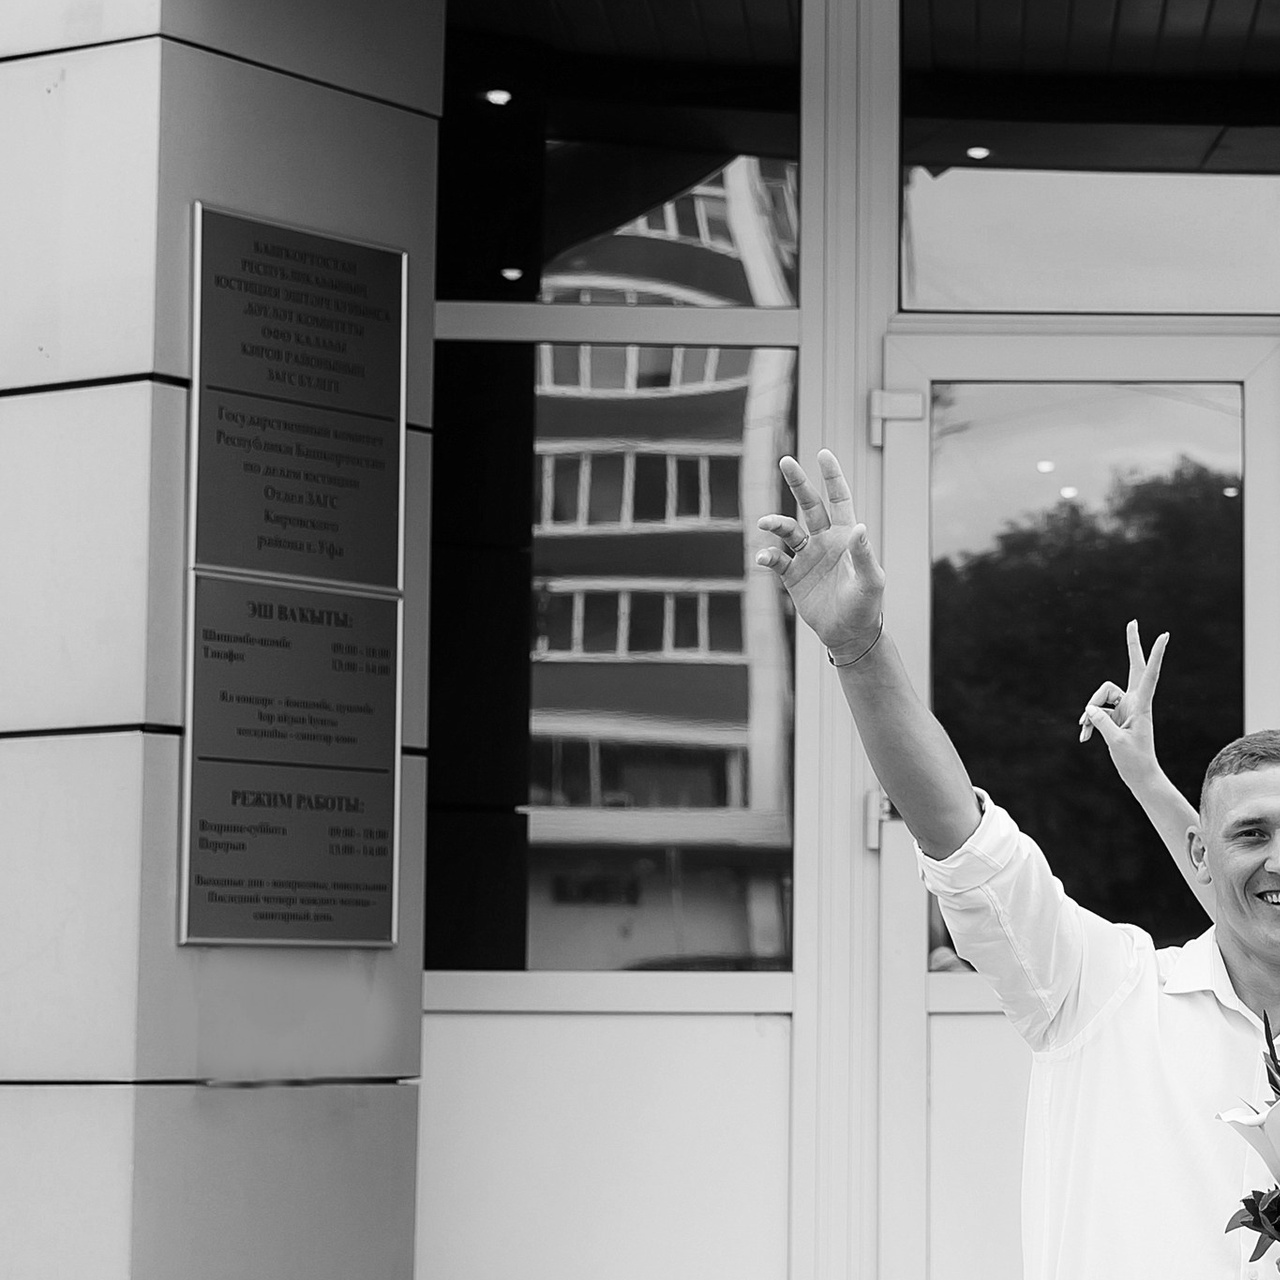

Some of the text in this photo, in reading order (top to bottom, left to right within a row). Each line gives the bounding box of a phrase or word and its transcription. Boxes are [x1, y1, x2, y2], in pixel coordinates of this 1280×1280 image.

[305, 491, 338, 510] ЗАГС
[246, 600, 274, 620] ЭШ
[231, 790, 365, 814] РЕЖИМ РАБОТЫ:
